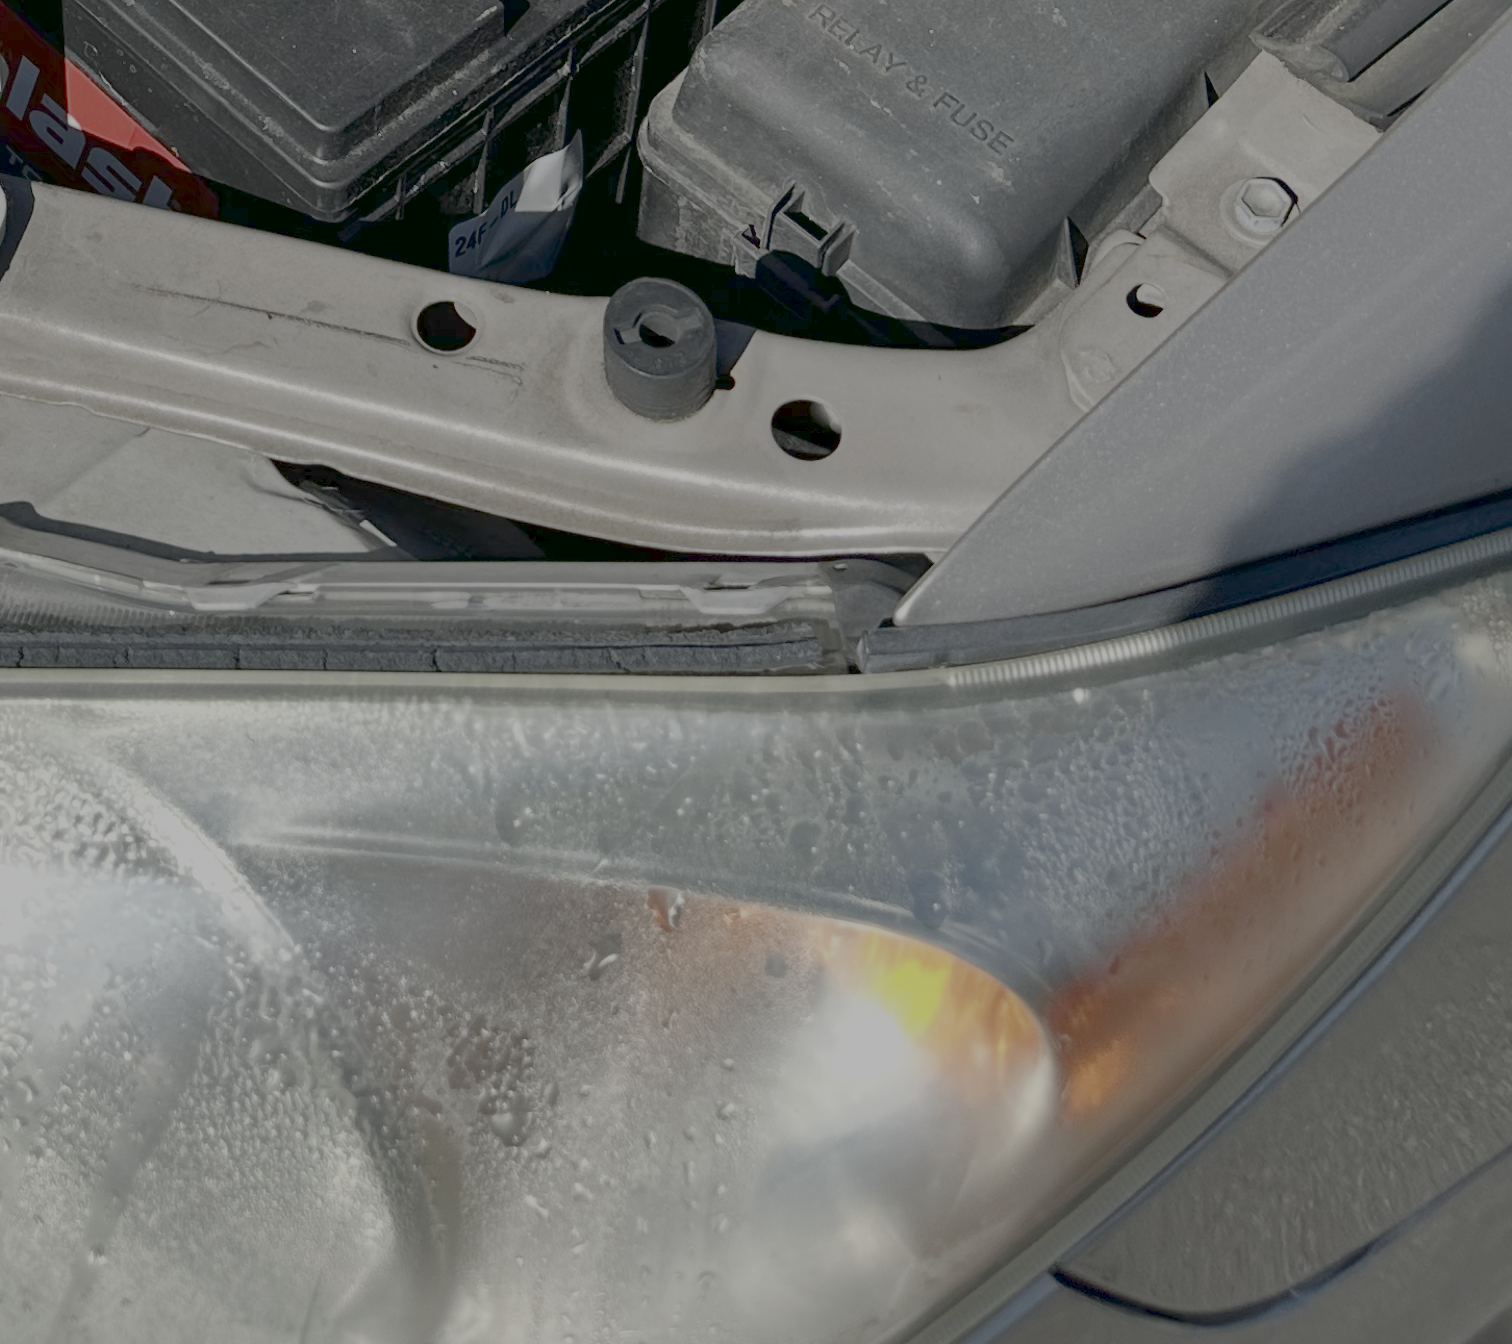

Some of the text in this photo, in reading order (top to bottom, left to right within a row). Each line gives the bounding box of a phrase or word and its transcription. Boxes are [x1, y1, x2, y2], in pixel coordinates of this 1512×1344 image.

[807, 3, 1015, 155] RELAY & FUSE
